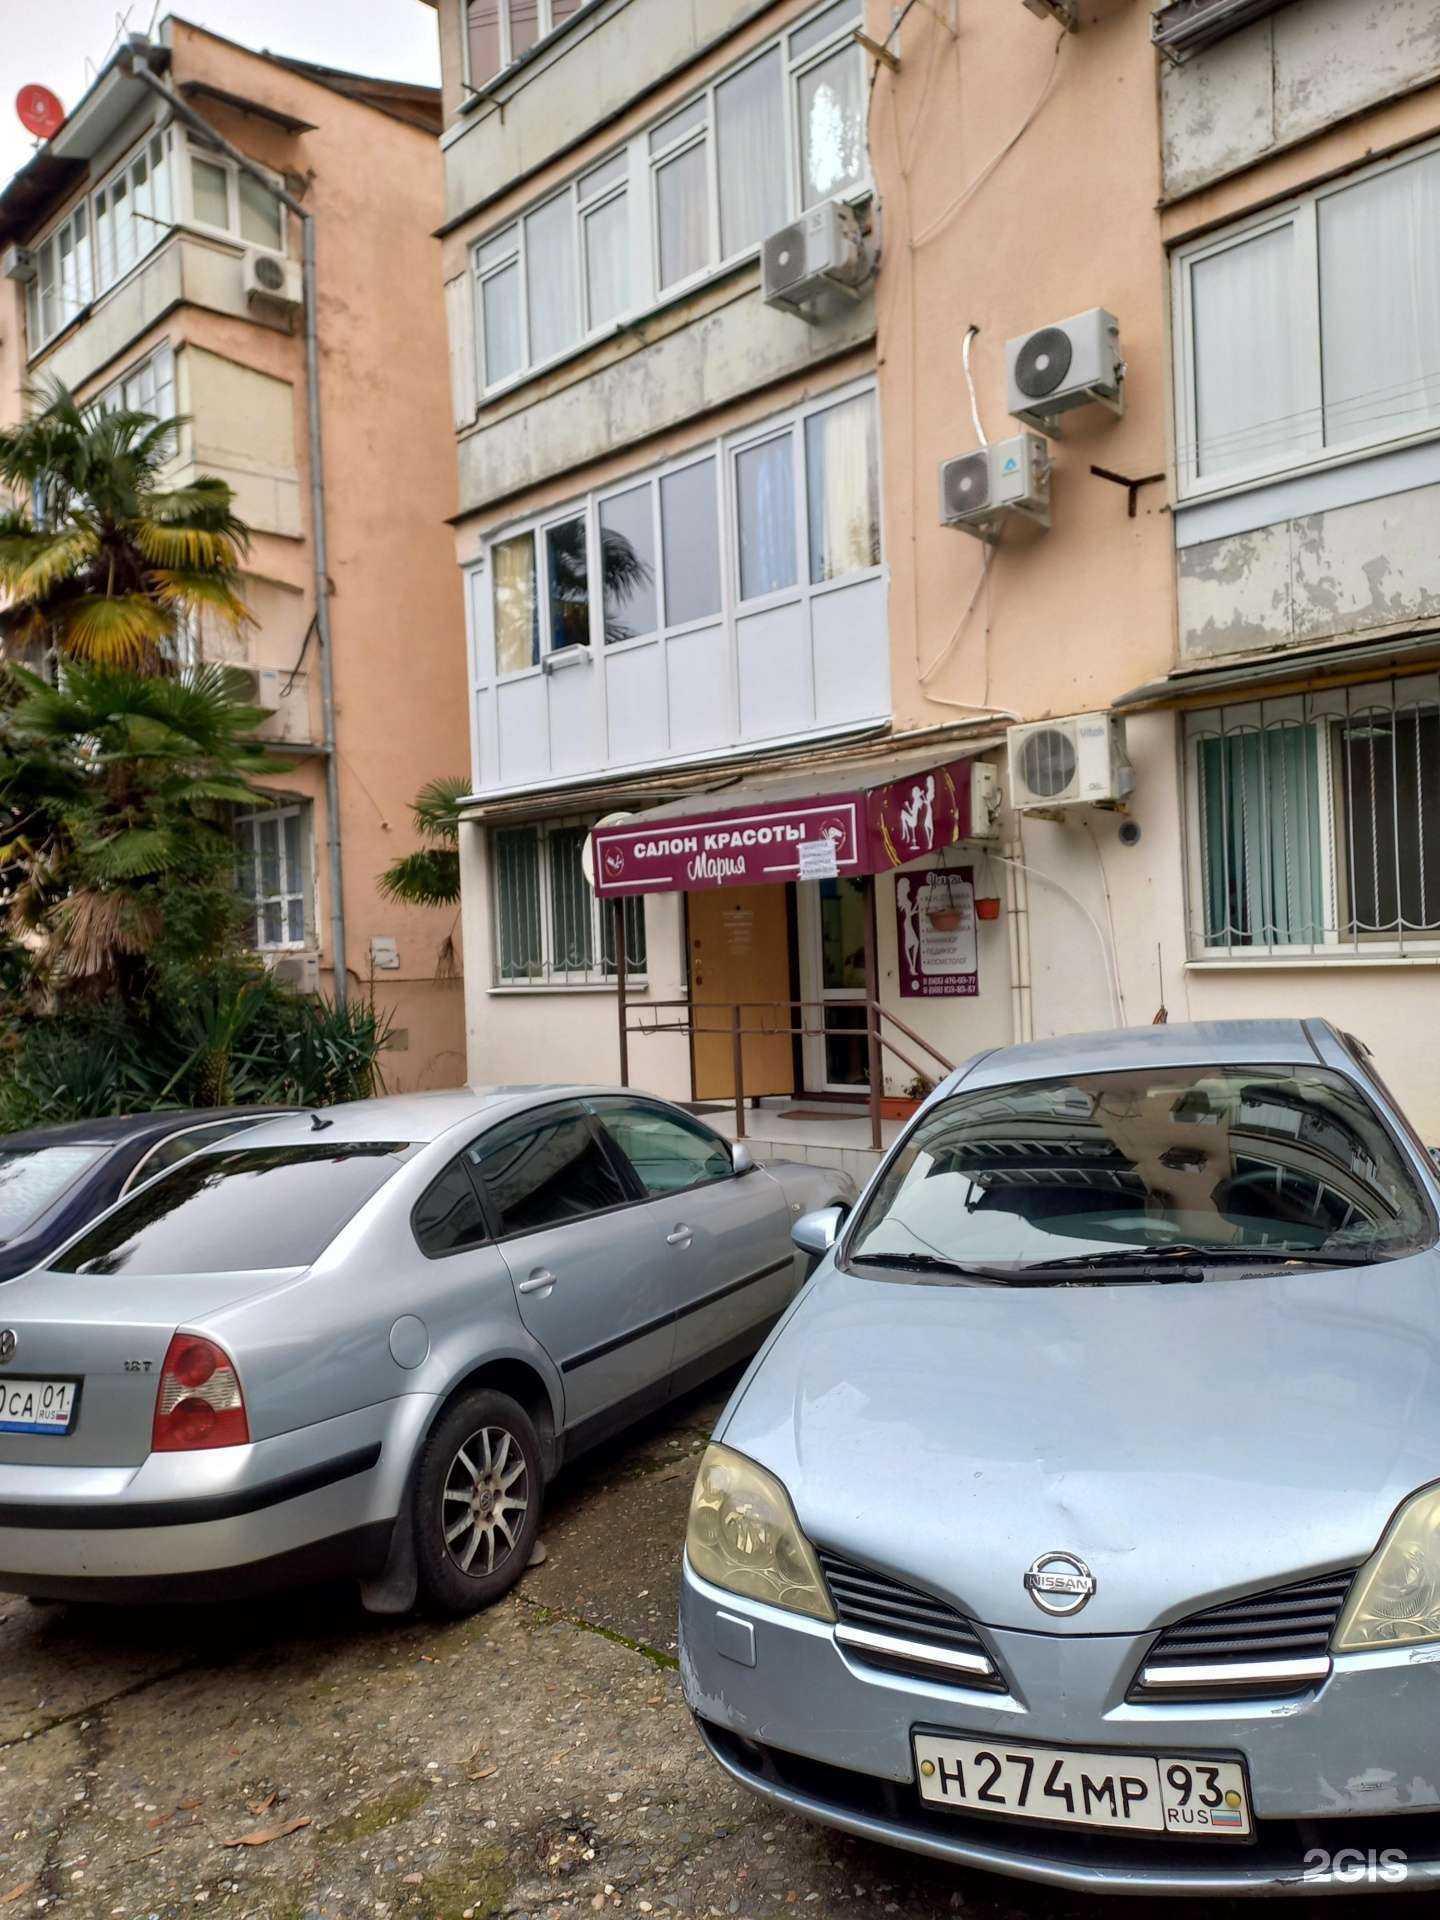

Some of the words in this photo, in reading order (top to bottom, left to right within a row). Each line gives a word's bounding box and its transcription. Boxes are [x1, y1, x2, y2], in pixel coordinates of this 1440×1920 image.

[633, 836, 698, 858] САЛОН
[704, 823, 806, 850] КРАСОТЫ
[687, 851, 746, 884] Мария
[43, 1385, 66, 1409] 01
[40, 1410, 56, 1420] RUS
[1029, 1574, 1088, 1590] NISSAN
[938, 1752, 1148, 1818] Н274МР
[1166, 1765, 1224, 1807] 93
[1168, 1808, 1209, 1824] RUS
